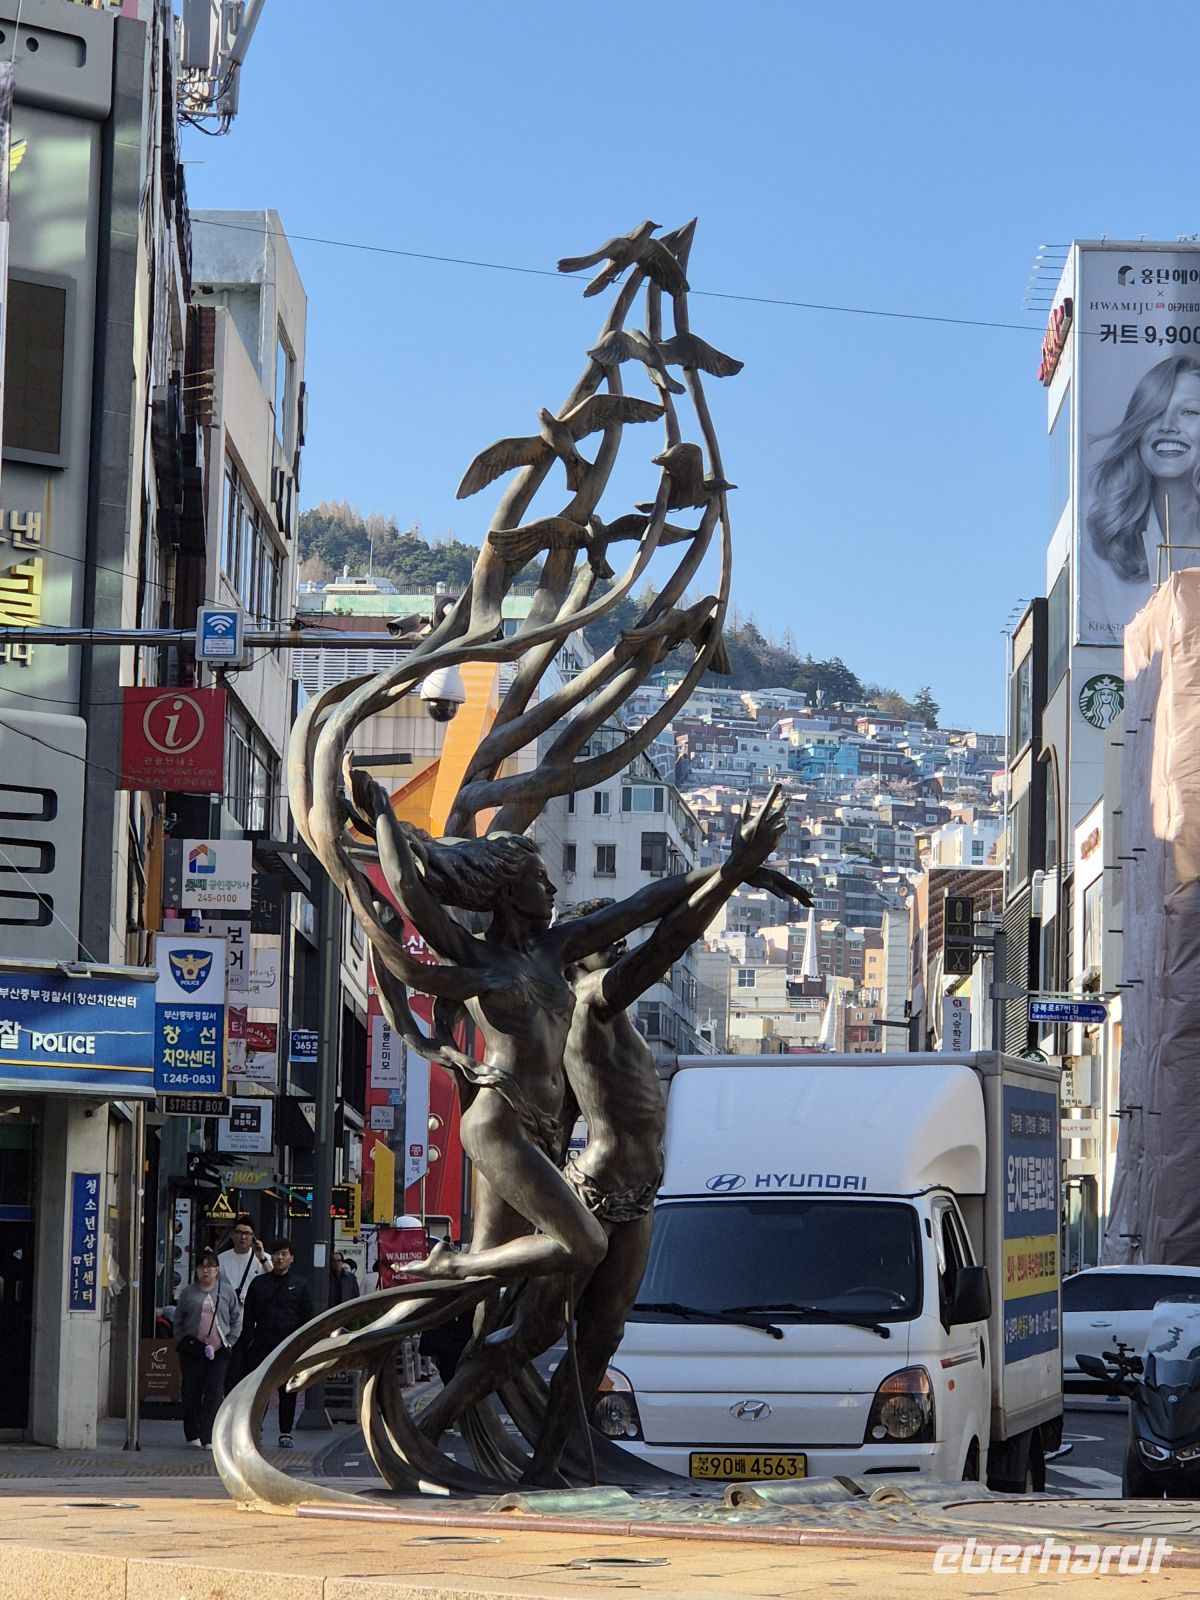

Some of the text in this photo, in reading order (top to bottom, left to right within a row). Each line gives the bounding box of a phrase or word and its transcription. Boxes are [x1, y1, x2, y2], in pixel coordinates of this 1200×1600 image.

[1090, 301, 1154, 315] HWAMIJU
[1100, 324, 1138, 344] 커트
[209, 880, 250, 891] 공인중개사
[197, 893, 237, 903] 245-0100
[0, 987, 137, 1008] 부산중부경찰서 창선치안센터
[164, 1010, 216, 1021] 부산중부경찰서
[1032, 1003, 1079, 1015] 광복로67번길
[0, 1019, 96, 1054] 찰 POLICE
[163, 1025, 216, 1045] 창 선
[295, 1041, 311, 1050] 365
[163, 1049, 216, 1068] 치안센터
[163, 1073, 216, 1084] T.245-0831
[169, 1099, 223, 1113] STREET BOX
[225, 1171, 268, 1185] BWAY
[755, 1173, 867, 1191] HYUNDAI
[83, 1179, 97, 1304] 청소년상담센터
[385, 1251, 422, 1261] WARUNG
[151, 1361, 167, 1370] Pace
[711, 1457, 746, 1475] 90배
[751, 1457, 797, 1476] 4563
